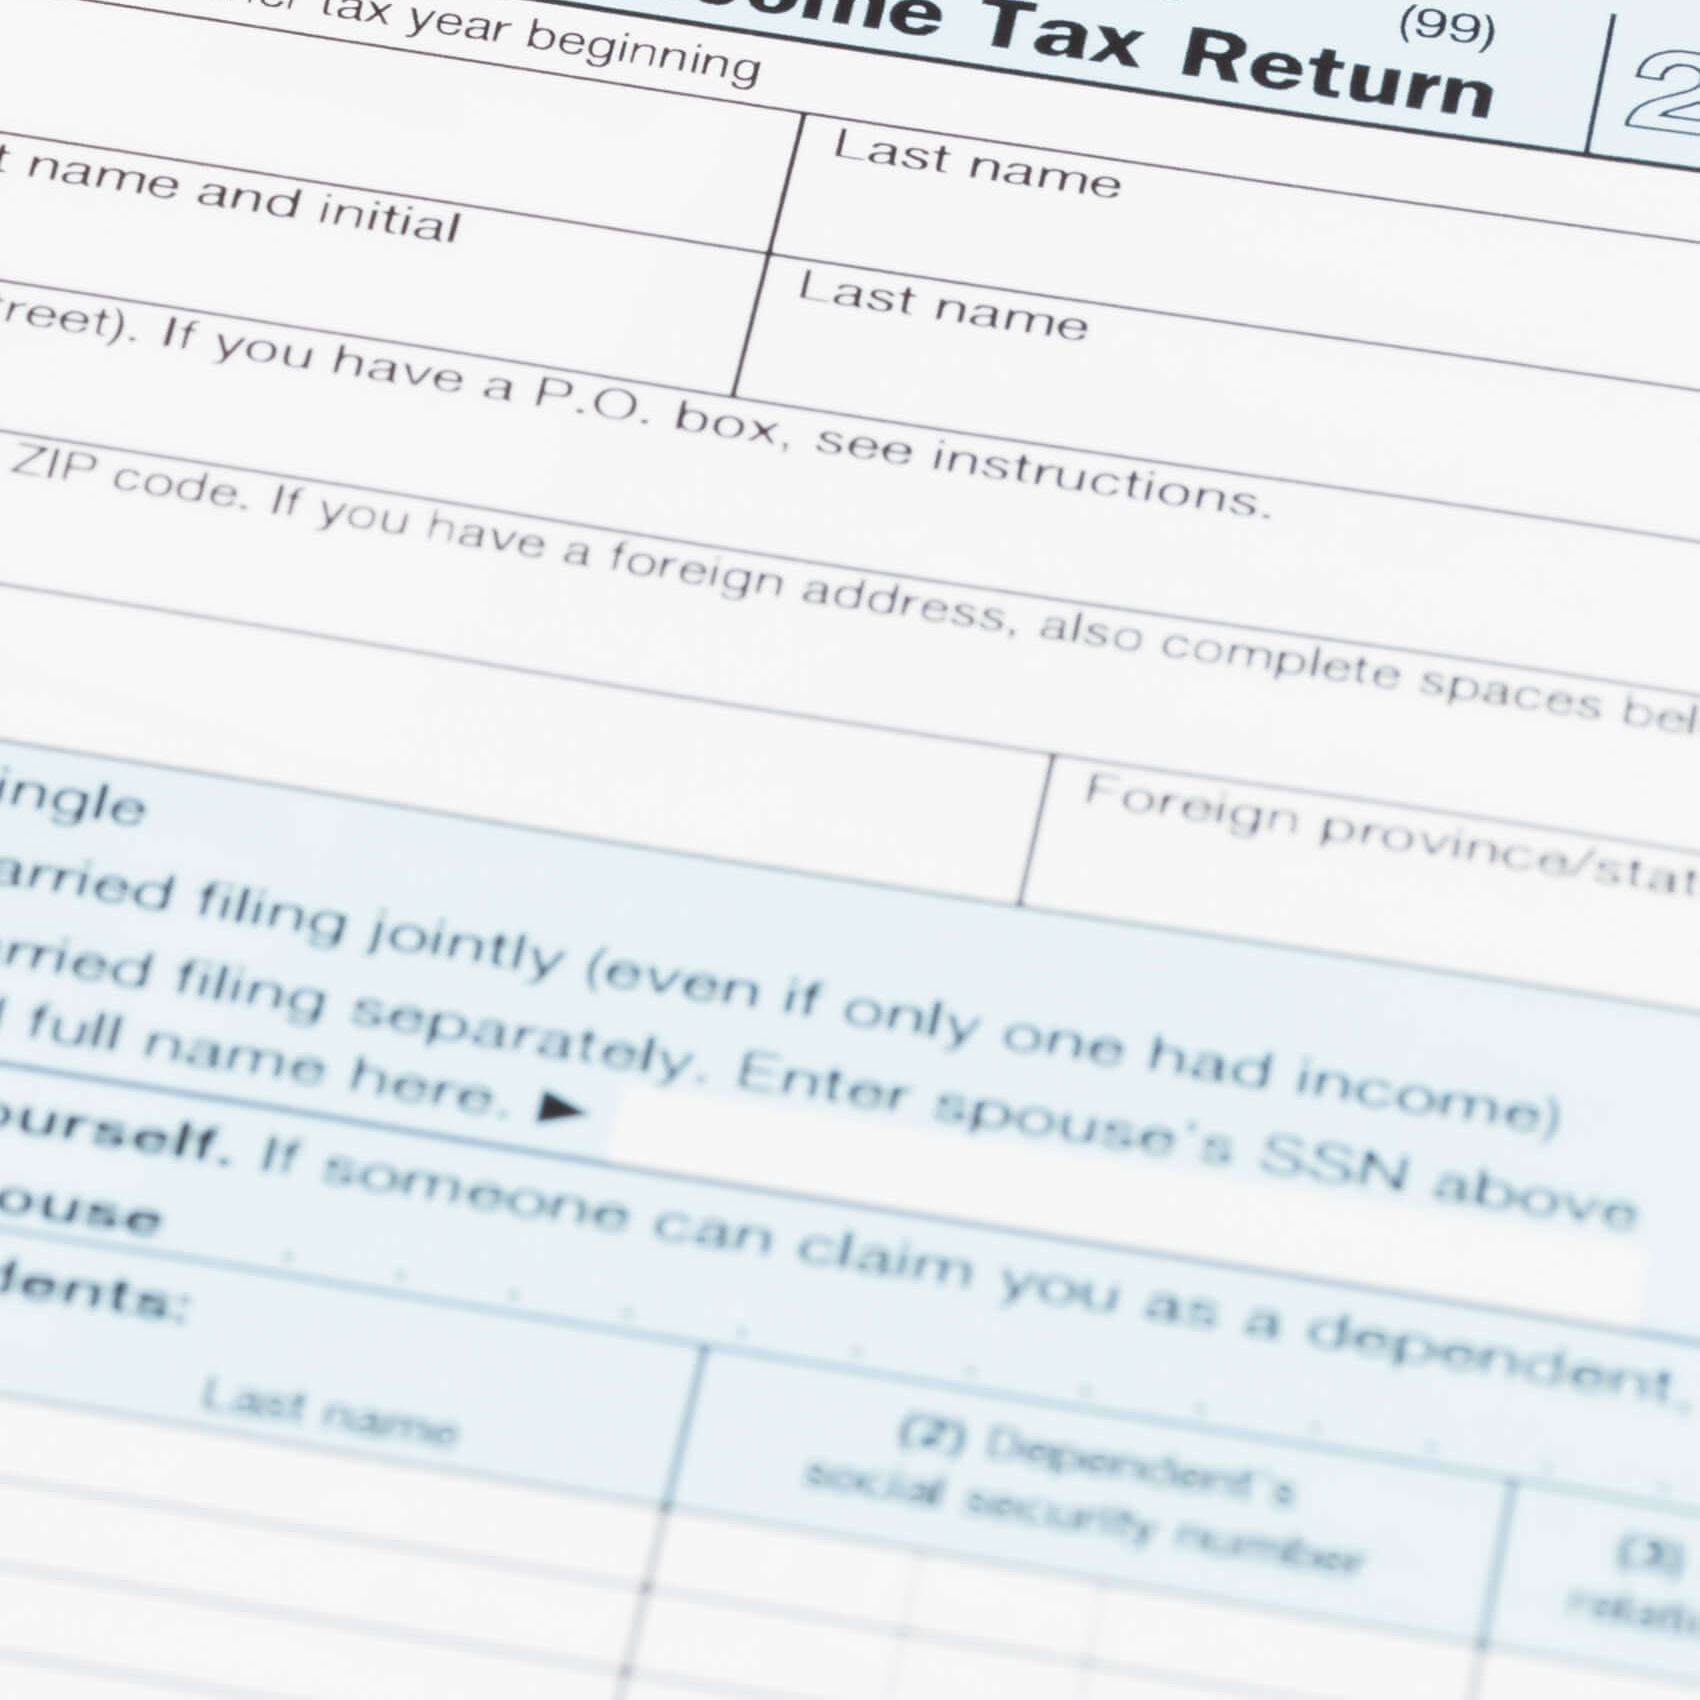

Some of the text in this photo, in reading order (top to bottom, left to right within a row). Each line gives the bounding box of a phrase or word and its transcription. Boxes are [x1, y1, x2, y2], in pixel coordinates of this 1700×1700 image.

[404, 6, 513, 43] year
[526, 17, 762, 91] beginning
[1399, 3, 1496, 54] (99)
[1180, 26, 1495, 120] Return
[28, 155, 180, 200] name
[196, 183, 303, 219] and
[319, 200, 462, 244] initial
[834, 127, 1122, 199] Last name
[799, 267, 1089, 341] Last name
[162, 315, 198, 349] If
[217, 333, 313, 370] you
[333, 343, 464, 392] have
[483, 377, 513, 402] a
[535, 376, 649, 425] P.O.
[675, 399, 788, 450] box,
[815, 431, 913, 465] see
[933, 448, 1270, 519] instructions.
[197, 879, 349, 951] filing
[365, 911, 566, 986] jointly
[585, 947, 761, 1009] (even
[783, 977, 825, 1018] if
[843, 998, 981, 1052] only
[1002, 1023, 1126, 1066] one
[1147, 1034, 1275, 1091] had
[1295, 1063, 1561, 1141] income)
